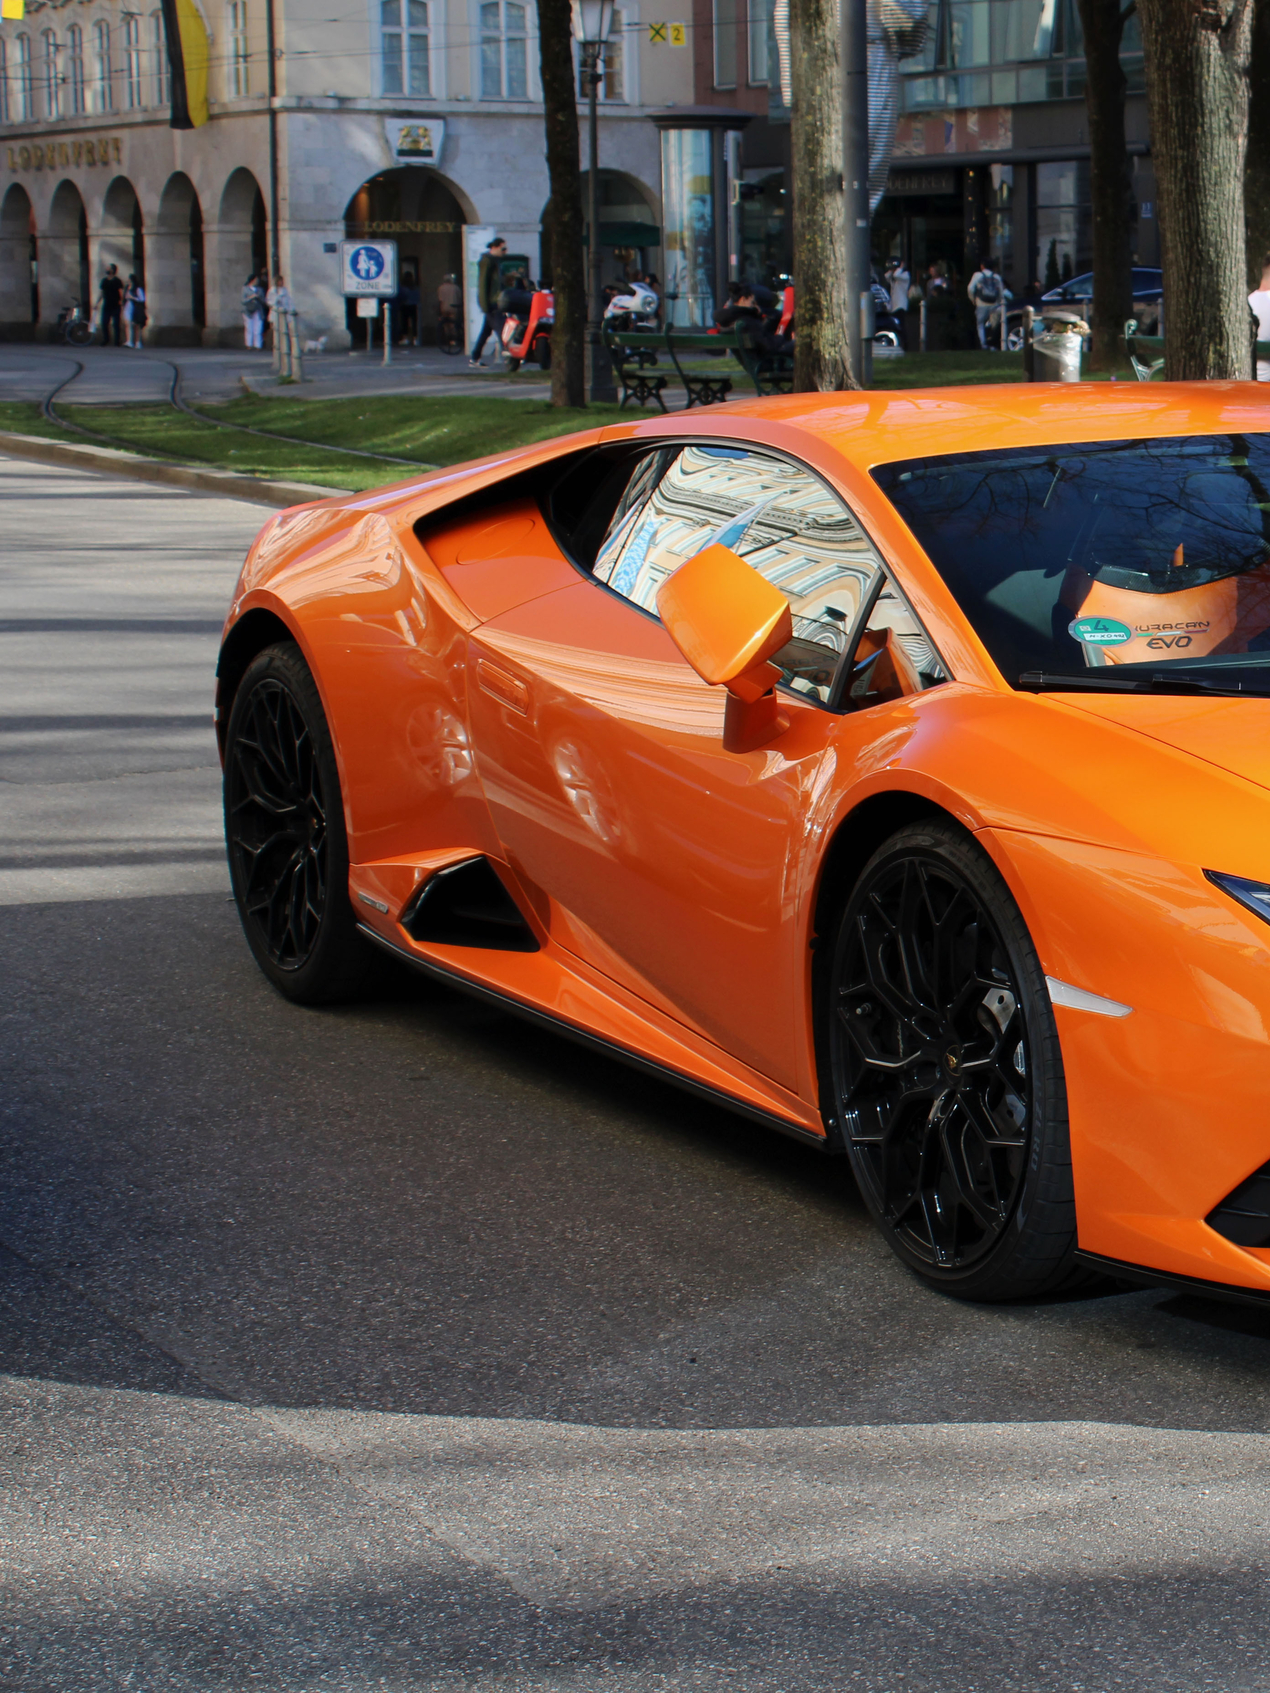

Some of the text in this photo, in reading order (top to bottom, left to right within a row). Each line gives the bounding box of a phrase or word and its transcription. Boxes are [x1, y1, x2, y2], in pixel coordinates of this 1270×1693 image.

[673, 28, 680, 41] 2
[364, 220, 456, 233] LODENFREY
[355, 281, 380, 291] ZONE
[1094, 619, 1109, 632] 4
[1146, 636, 1192, 649] EVO
